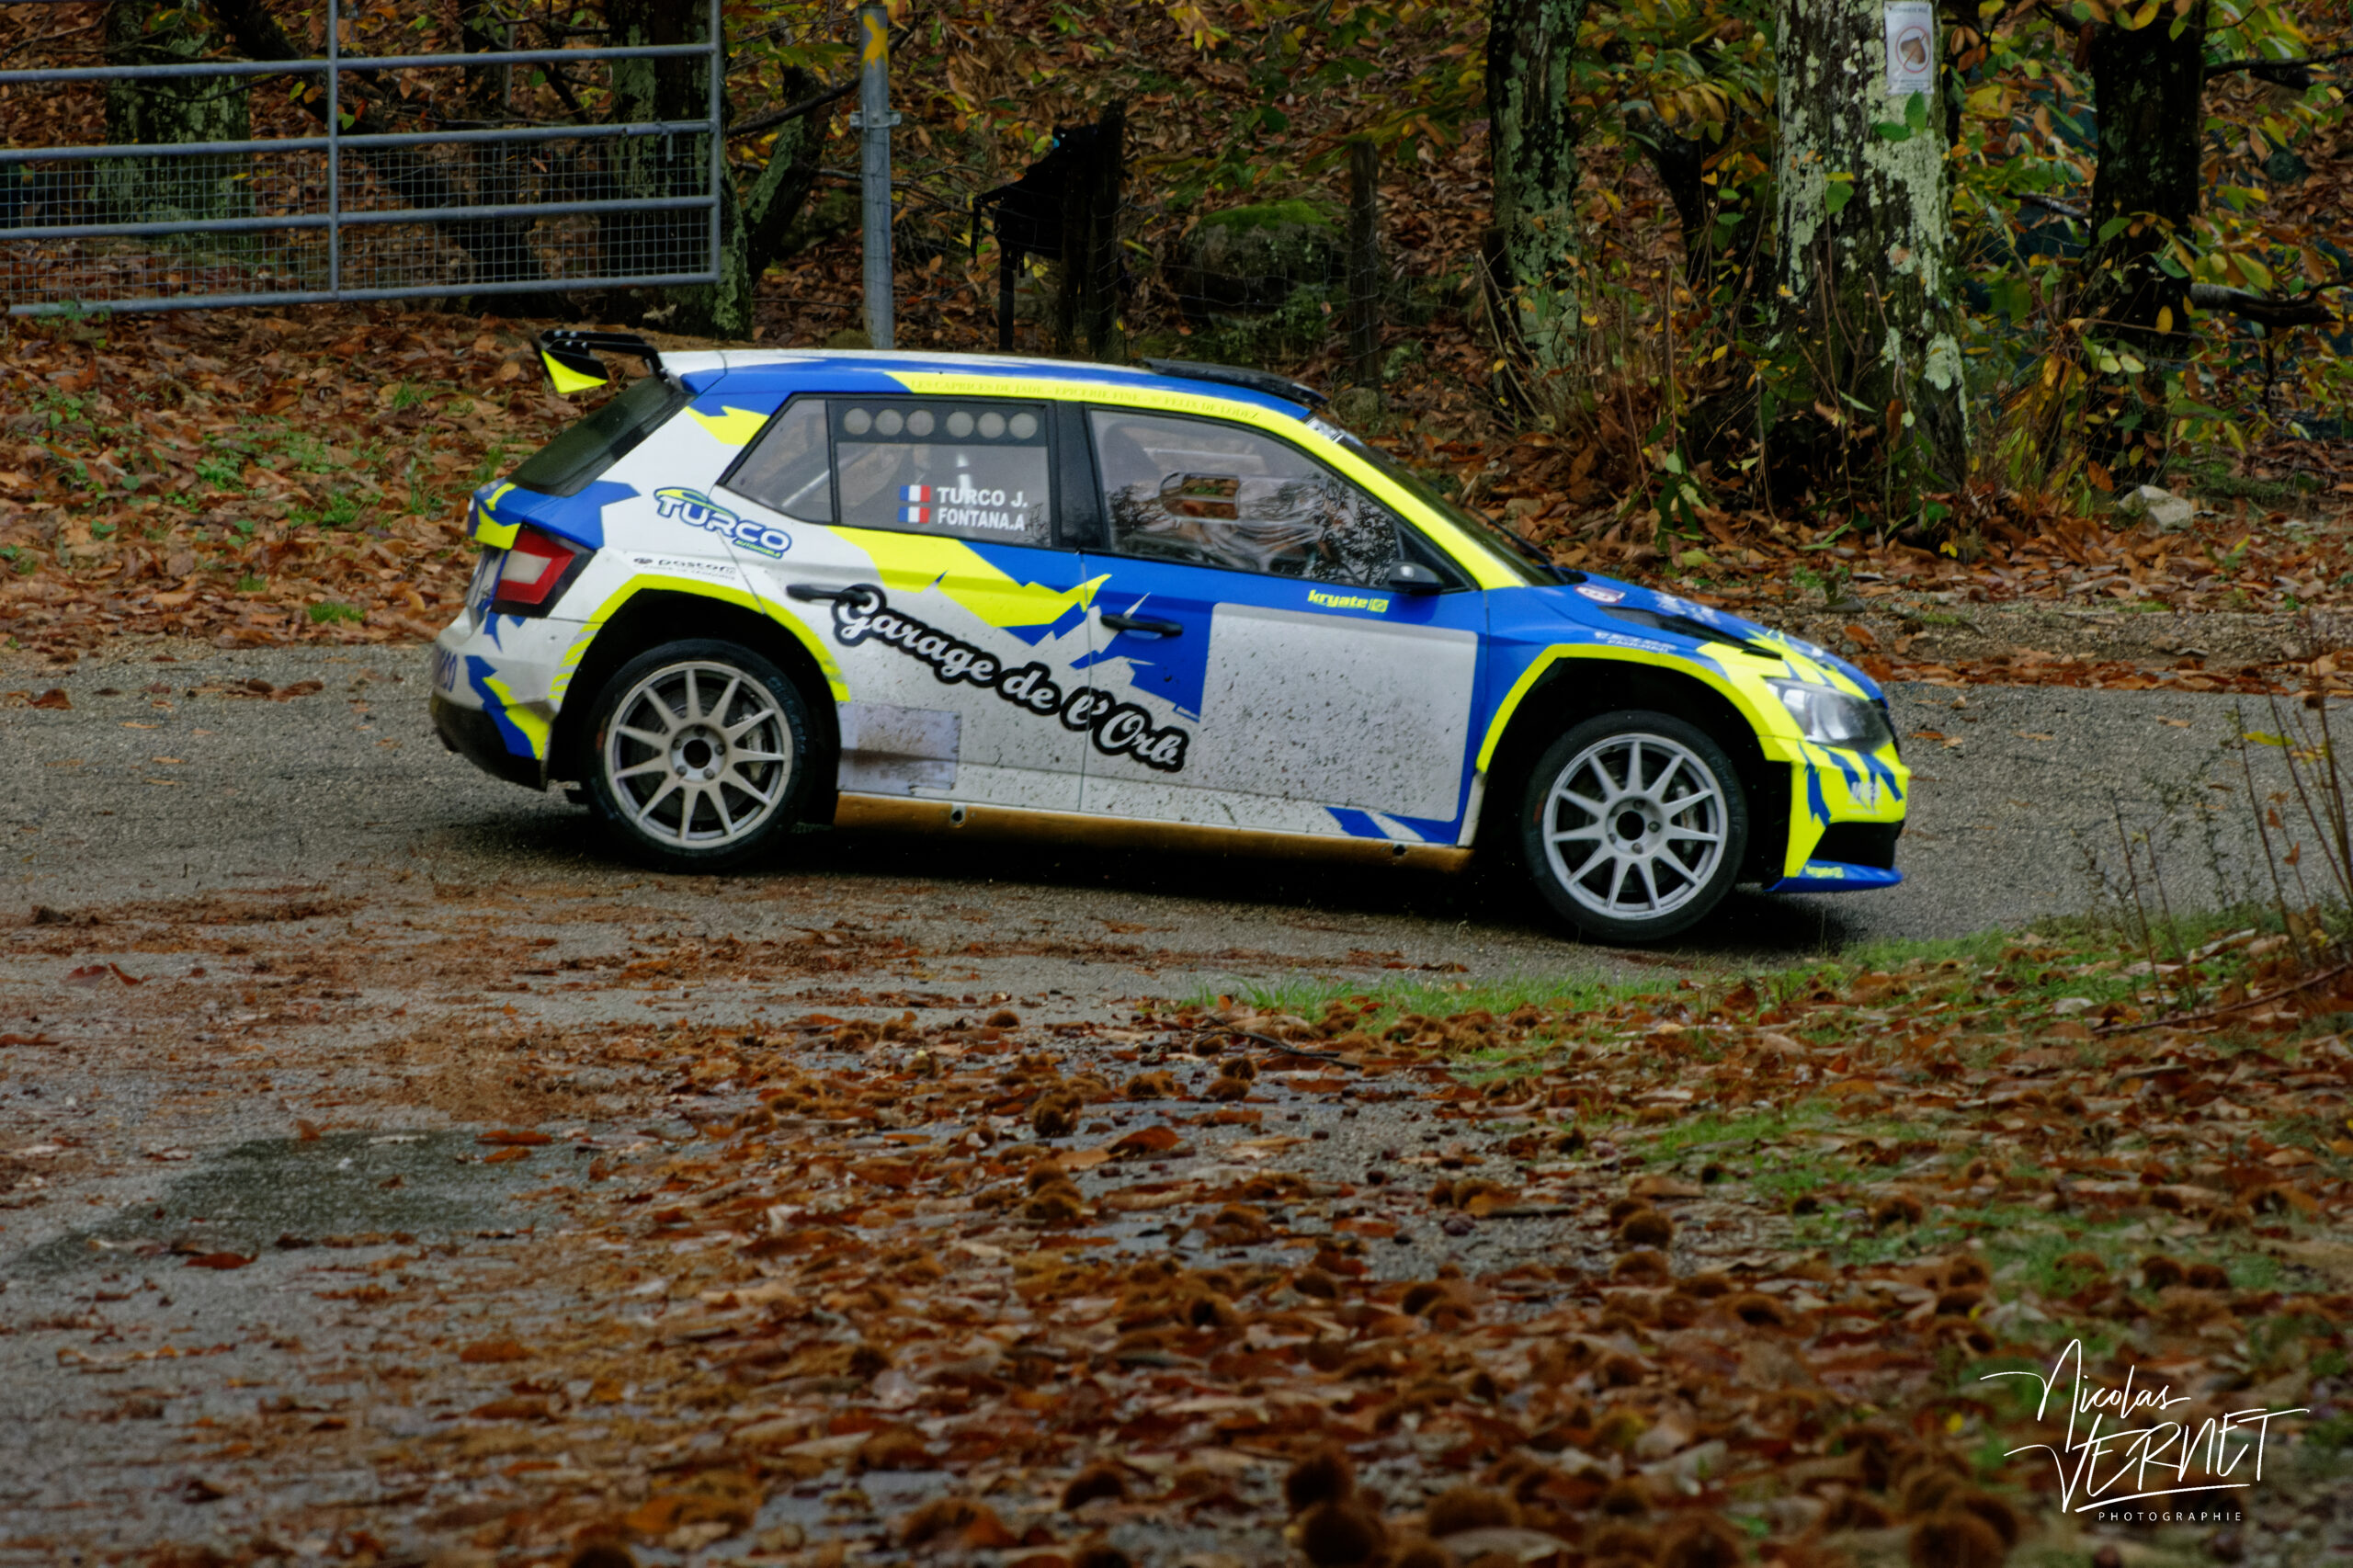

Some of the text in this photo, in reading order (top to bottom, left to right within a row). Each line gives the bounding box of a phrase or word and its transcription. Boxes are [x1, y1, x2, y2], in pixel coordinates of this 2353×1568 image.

[936, 486, 1029, 508] TURCO J.
[656, 494, 792, 552] TURCO
[938, 507, 1026, 531] FONTANA.A
[835, 591, 1179, 767] Garage de l'Orb
